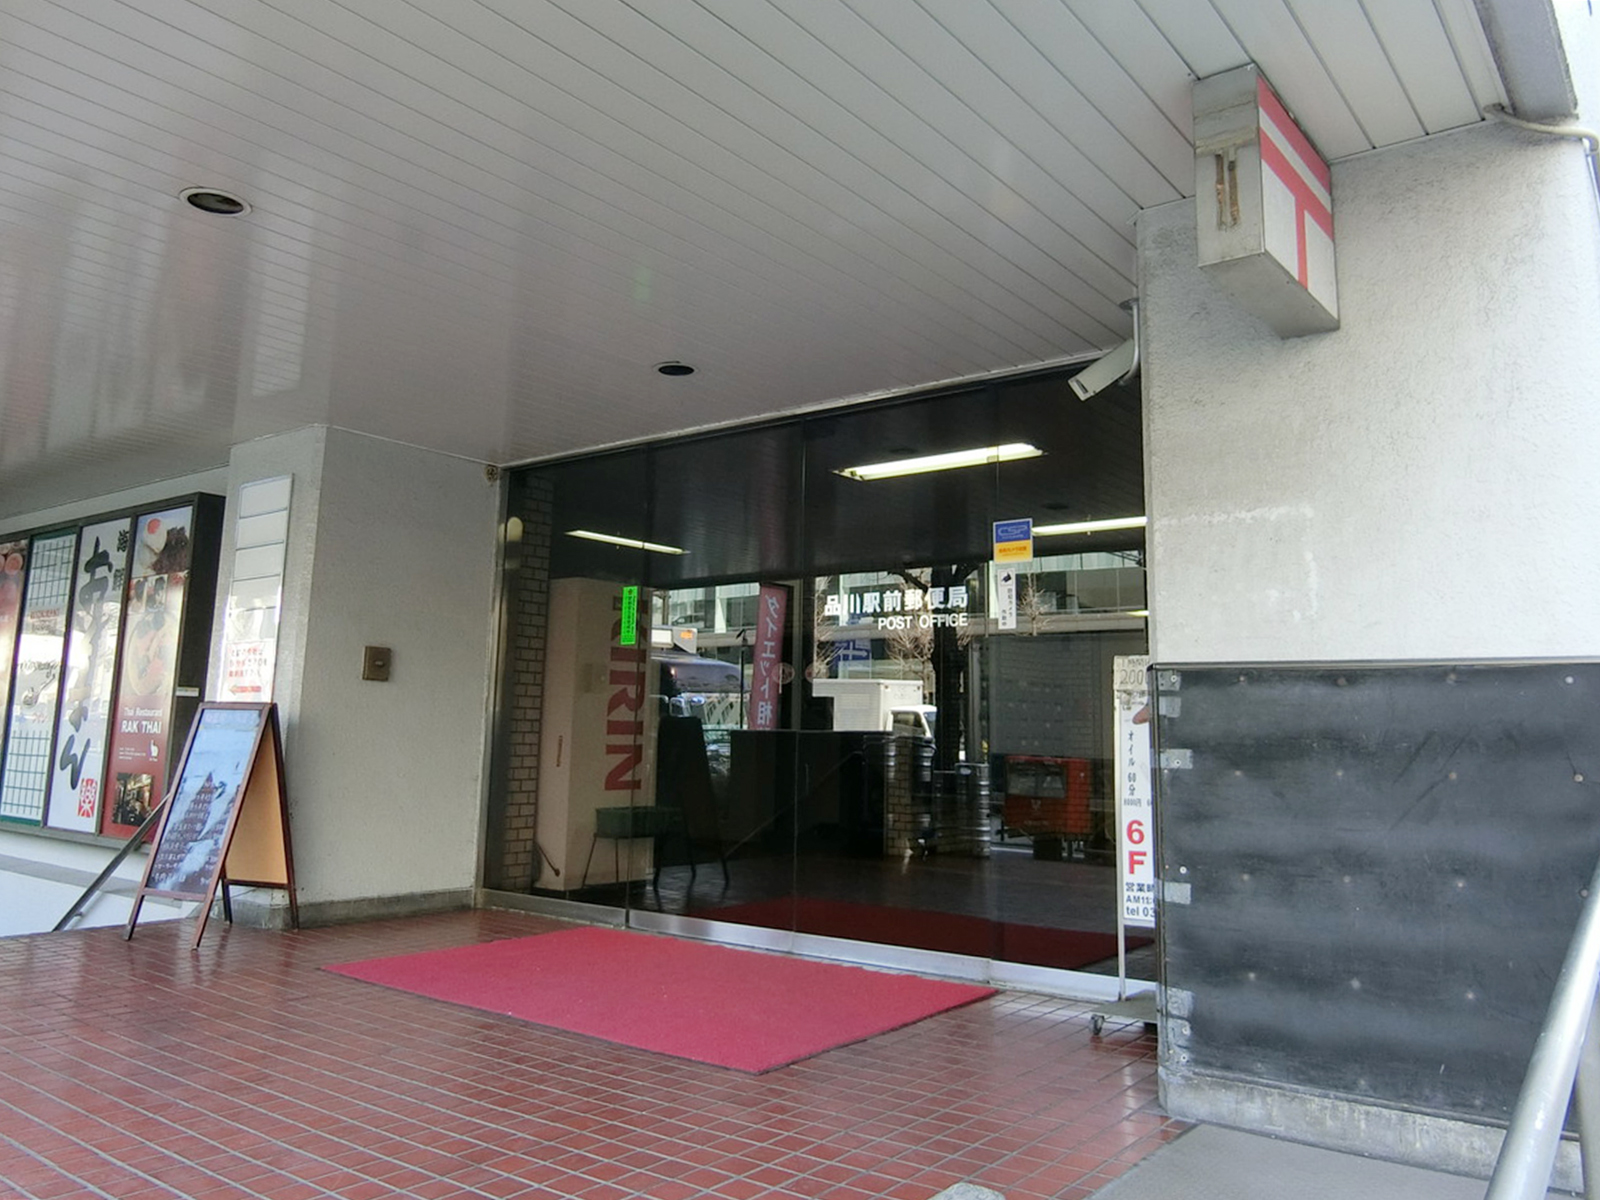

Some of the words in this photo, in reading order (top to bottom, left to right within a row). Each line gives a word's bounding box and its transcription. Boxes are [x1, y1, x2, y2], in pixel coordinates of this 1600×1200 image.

[824, 586, 968, 616] 品川駅前郵便局
[878, 616, 912, 631] POST
[919, 613, 968, 629] OFFICE
[1120, 668, 1148, 686] 200
[121, 720, 139, 733] RAK
[141, 720, 162, 734] THAI
[1126, 906, 1139, 916] tel
